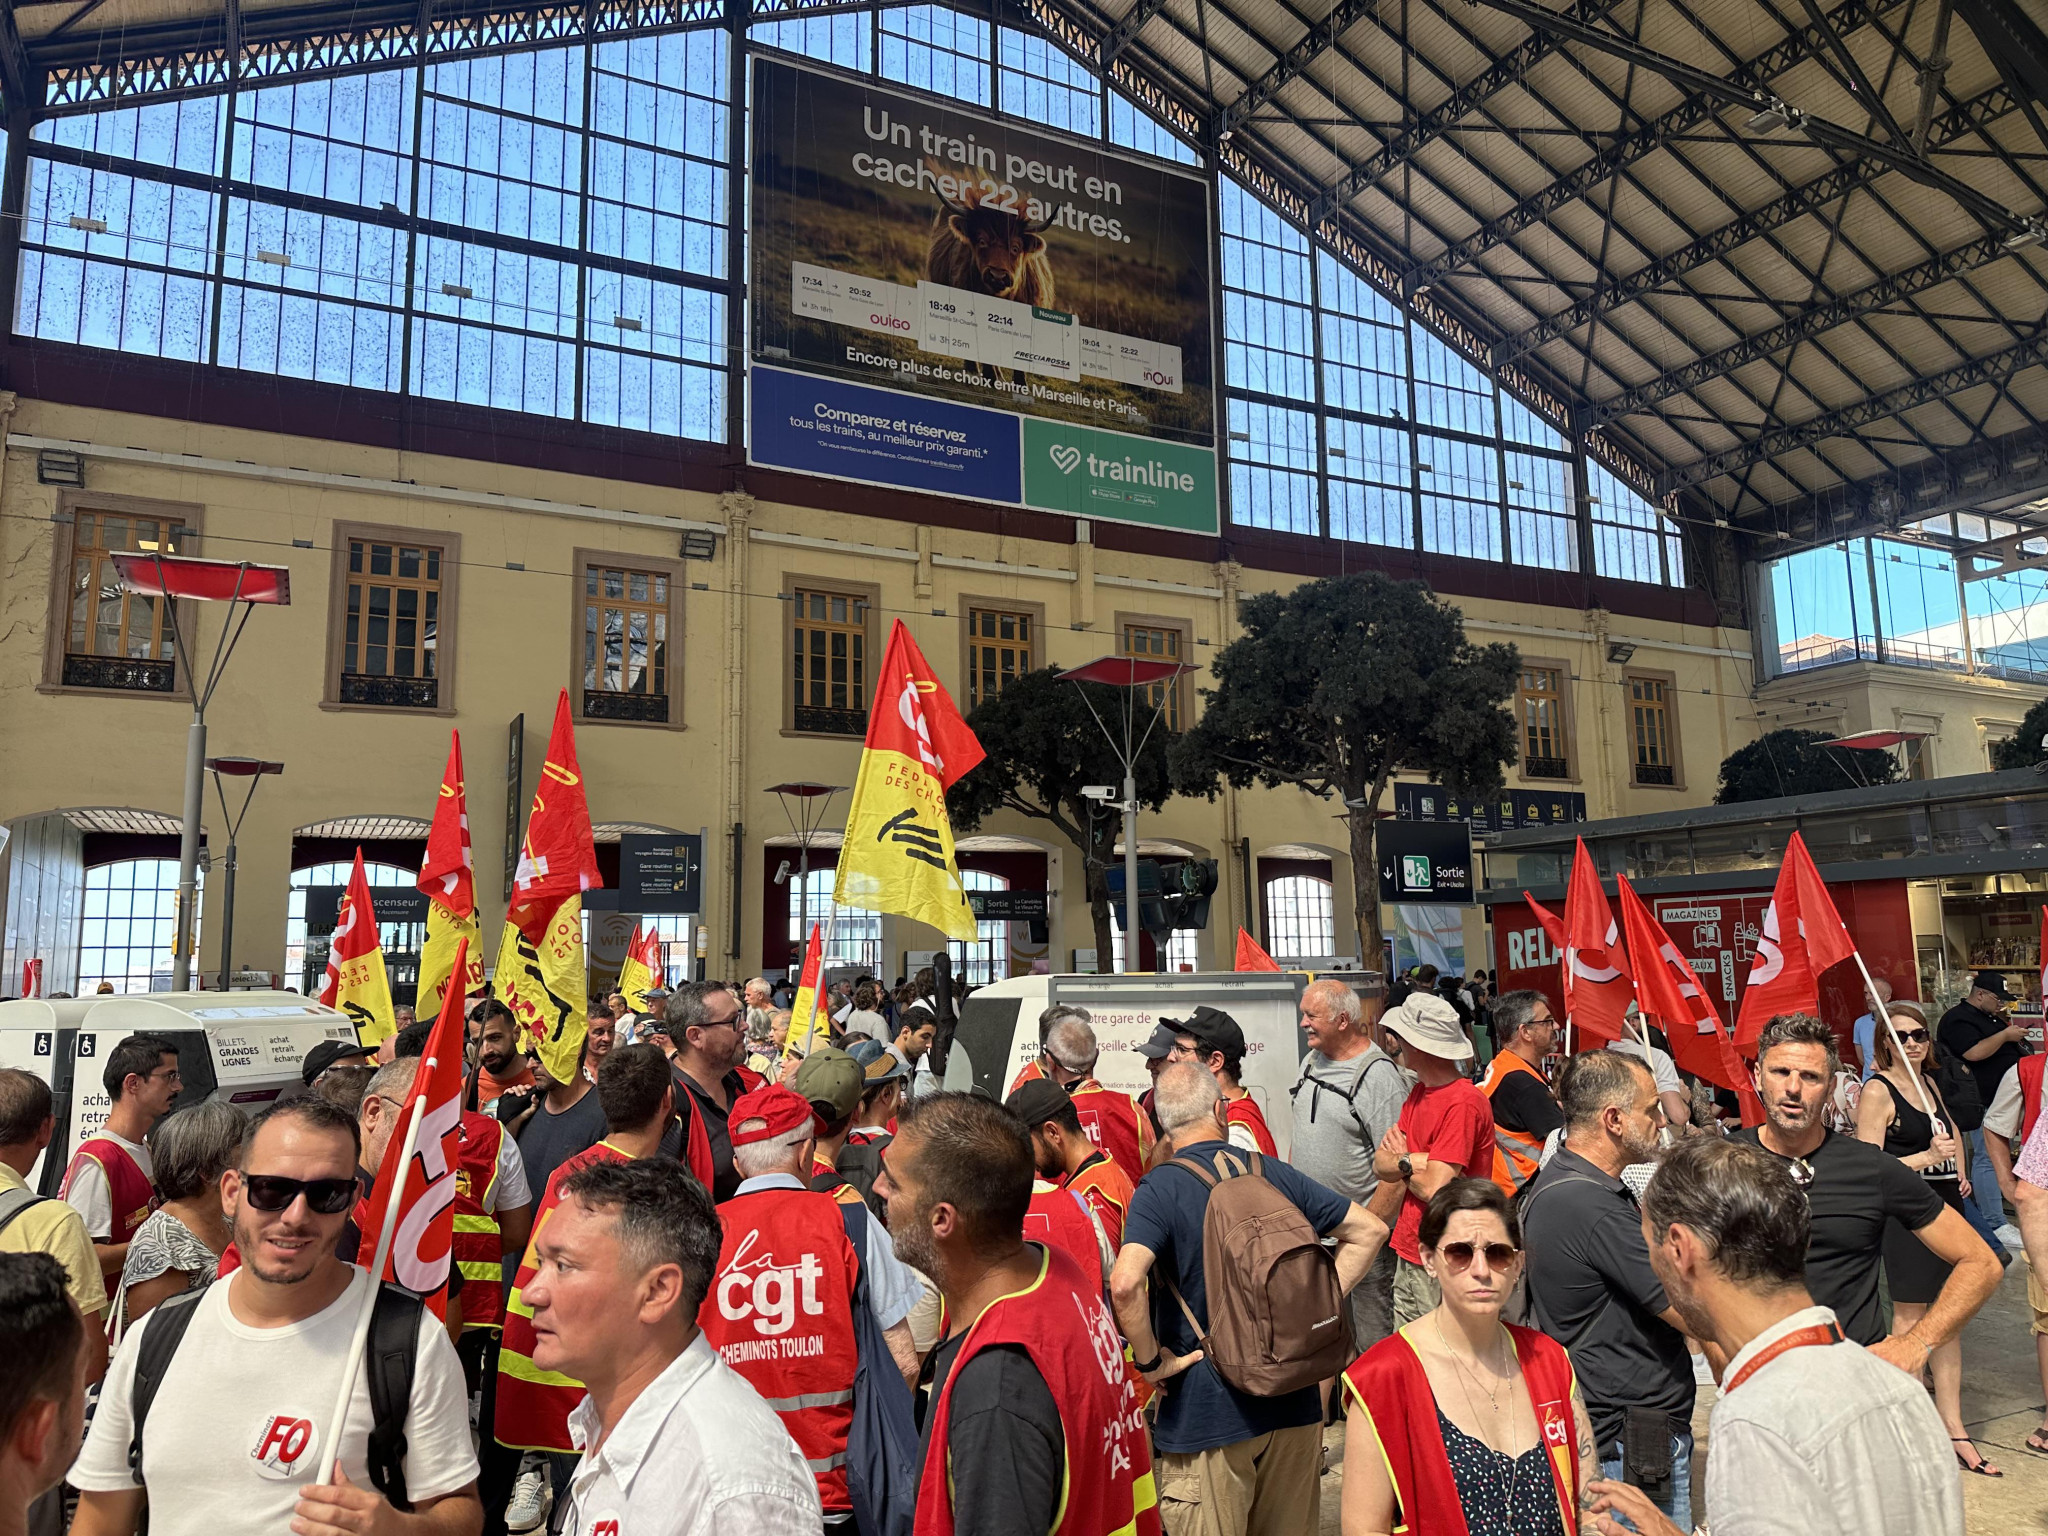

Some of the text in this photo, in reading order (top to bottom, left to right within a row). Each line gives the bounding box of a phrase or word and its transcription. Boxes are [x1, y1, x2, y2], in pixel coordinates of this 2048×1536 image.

[863, 105, 1122, 205] Un train peut en
[852, 152, 1131, 244] cacher 22 autres.
[802, 276, 871, 298] 17:34 20:52
[928, 300, 1013, 326] 18:49 22:14
[1039, 310, 1067, 322] Nouveau
[939, 335, 970, 349] 3h 25m
[1082, 338, 1139, 356] 19:04 22:22
[1014, 350, 1071, 368] FRECCIAROSSA
[846, 346, 1141, 417] Encore plus de choix entre Marseille et Paris.
[814, 402, 967, 443] Comparez et réservez
[789, 415, 814, 430] tous
[816, 419, 831, 433] les
[833, 423, 866, 440] trains,
[867, 431, 881, 442] au
[882, 433, 923, 449] meilleur
[925, 440, 945, 453] prix
[1086, 452, 1195, 493] trainline
[885, 775, 910, 790] DES
[1436, 866, 1465, 879] Sortie
[373, 899, 420, 907] scenseur
[987, 900, 1009, 908] Sortie
[1666, 909, 1719, 920] MAGAZINES
[1508, 927, 1563, 971] RELA
[1689, 960, 1713, 971] EAUX
[1089, 1012, 1151, 1027] otre gare de
[217, 1037, 247, 1048] BILLETS
[269, 1035, 290, 1044] achat
[1020, 1041, 1039, 1051] ach
[1097, 1039, 1128, 1052] rseille
[219, 1046, 260, 1057] GRANDES
[272, 1045, 296, 1054] retrait
[1244, 1041, 1265, 1055] age
[222, 1057, 251, 1067] LIGNES
[274, 1054, 304, 1064] échange
[1125, 1081, 1137, 1089] des
[1137, 1081, 1153, 1089] déch
[83, 1093, 111, 1106] acha
[81, 1111, 112, 1123] retra
[1079, 1121, 1101, 1144] gt
[719, 1228, 783, 1279] la
[717, 1253, 824, 1335] cgt
[719, 1335, 824, 1365] CHEMINOTS TOULON
[250, 1415, 275, 1459] Cheminots
[257, 1415, 313, 1463] FO
[1544, 1419, 1568, 1444] cg
